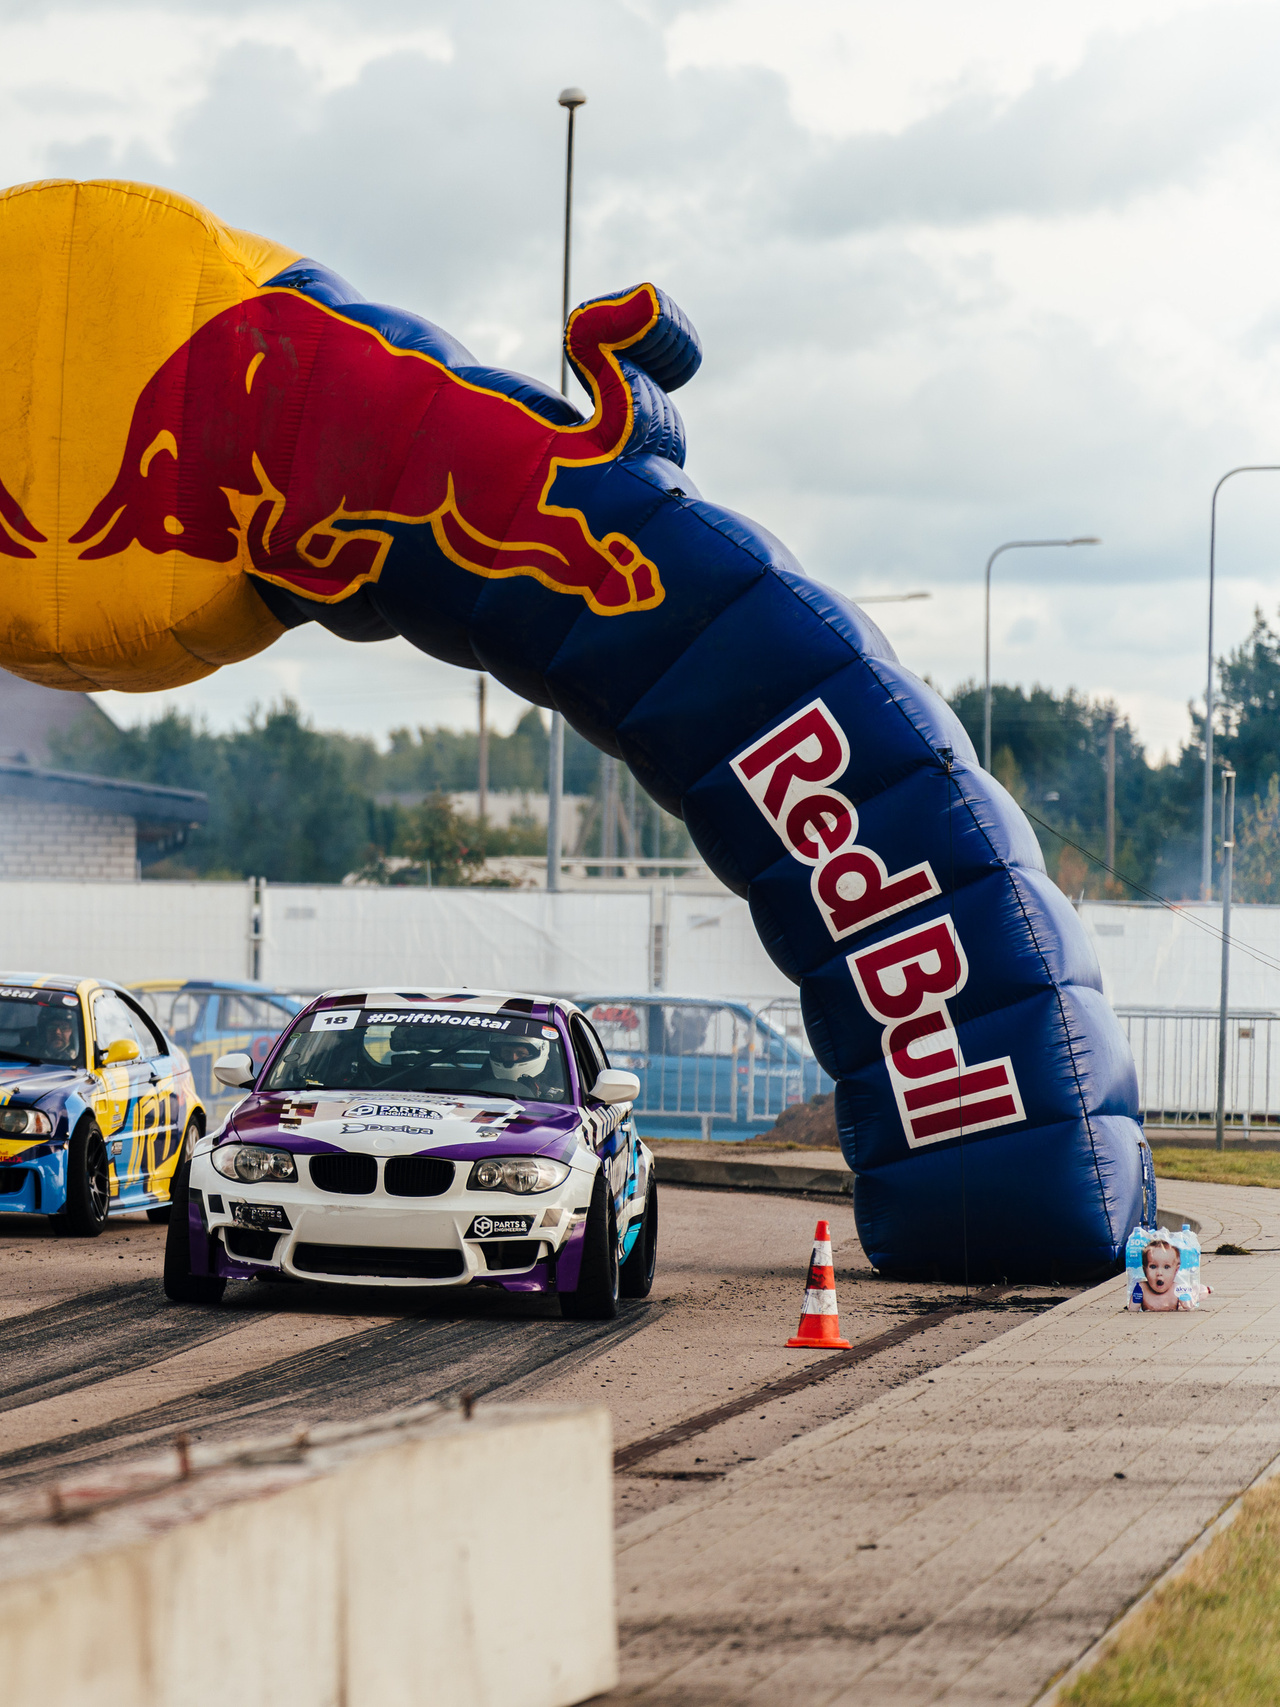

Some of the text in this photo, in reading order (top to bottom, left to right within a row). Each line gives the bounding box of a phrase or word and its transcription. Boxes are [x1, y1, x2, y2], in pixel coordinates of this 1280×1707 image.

[733, 702, 1022, 1144] Red Bull
[324, 1016, 349, 1025] 18
[380, 1105, 428, 1115] PARTS
[521, 1220, 527, 1228] &
